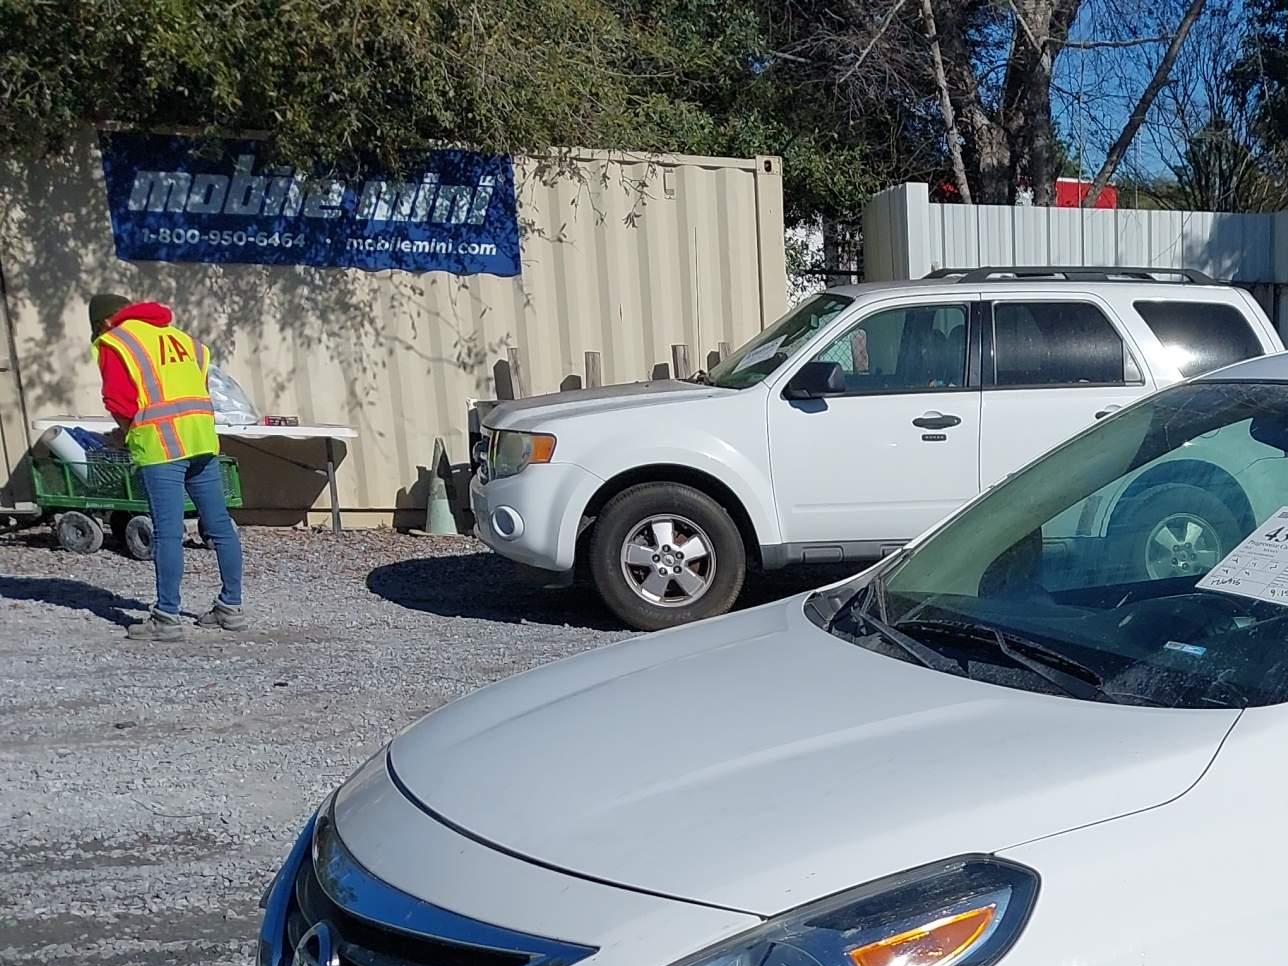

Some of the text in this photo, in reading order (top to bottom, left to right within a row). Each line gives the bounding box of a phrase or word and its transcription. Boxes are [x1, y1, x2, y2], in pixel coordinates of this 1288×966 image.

[127, 154, 496, 225] mobile mini
[142, 227, 498, 256] 1-800-950-6464 mobilemini.com
[157, 334, 194, 366] IAA
